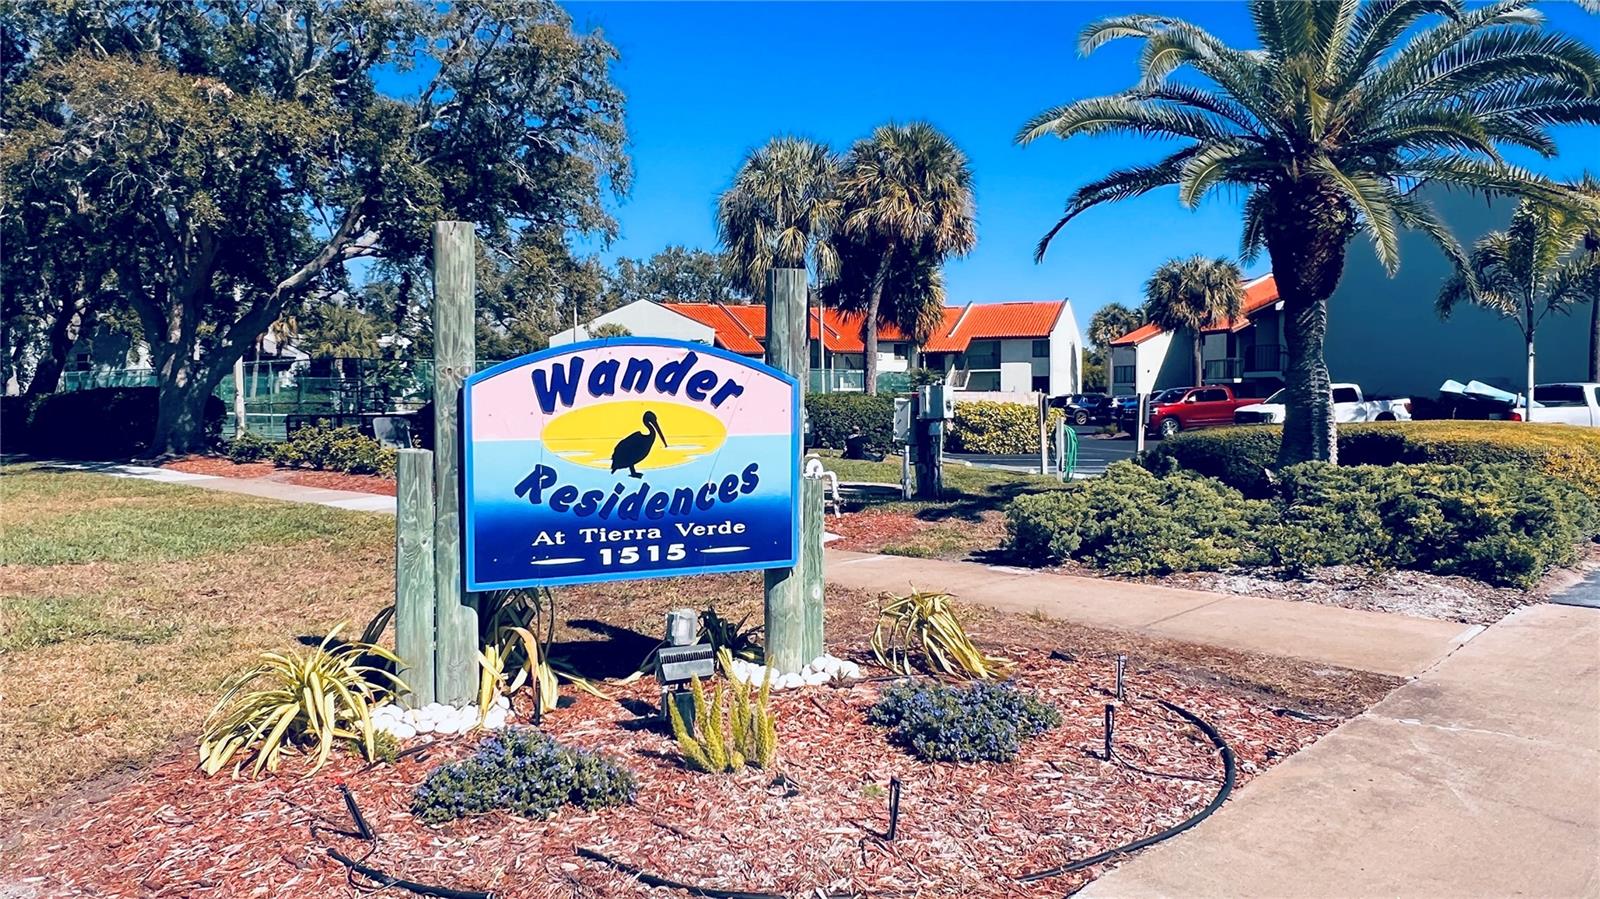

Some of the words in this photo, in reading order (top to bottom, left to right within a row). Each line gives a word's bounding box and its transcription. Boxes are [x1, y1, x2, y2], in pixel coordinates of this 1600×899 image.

[531, 351, 744, 415] Wander
[514, 462, 760, 521] Residences
[532, 531, 566, 547] At
[578, 527, 662, 543] Tierra
[675, 521, 746, 537] Verde
[599, 543, 687, 566] 1515
